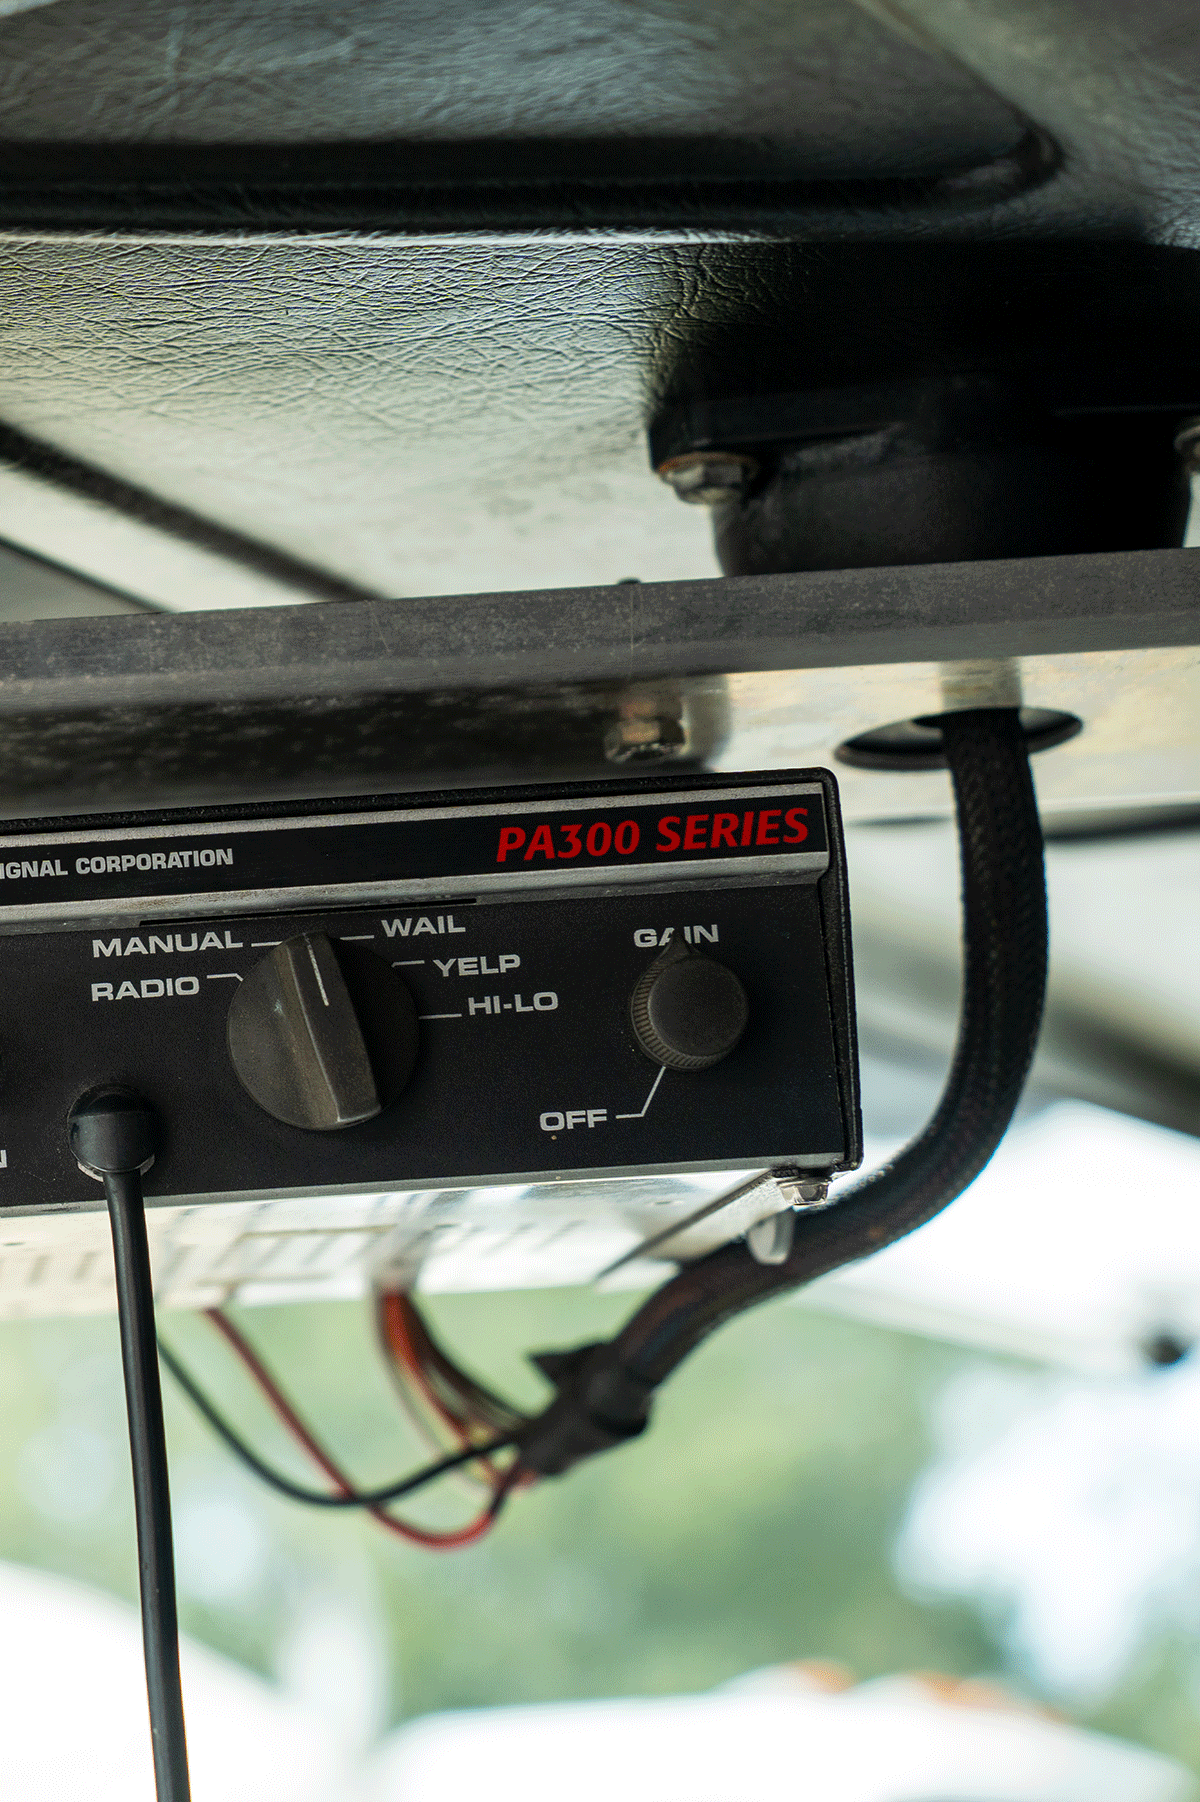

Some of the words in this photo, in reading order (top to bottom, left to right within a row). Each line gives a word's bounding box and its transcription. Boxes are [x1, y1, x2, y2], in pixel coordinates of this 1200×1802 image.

[497, 820, 641, 862] PA300
[656, 808, 809, 852] SERIES
[75, 848, 234, 875] CORPORATION
[381, 914, 466, 937] WAIL
[92, 930, 244, 958] MANUAL
[433, 953, 521, 977] YELP
[90, 976, 200, 1002] RADIO
[467, 991, 559, 1016] HI-LO
[539, 1108, 608, 1132] OFF
